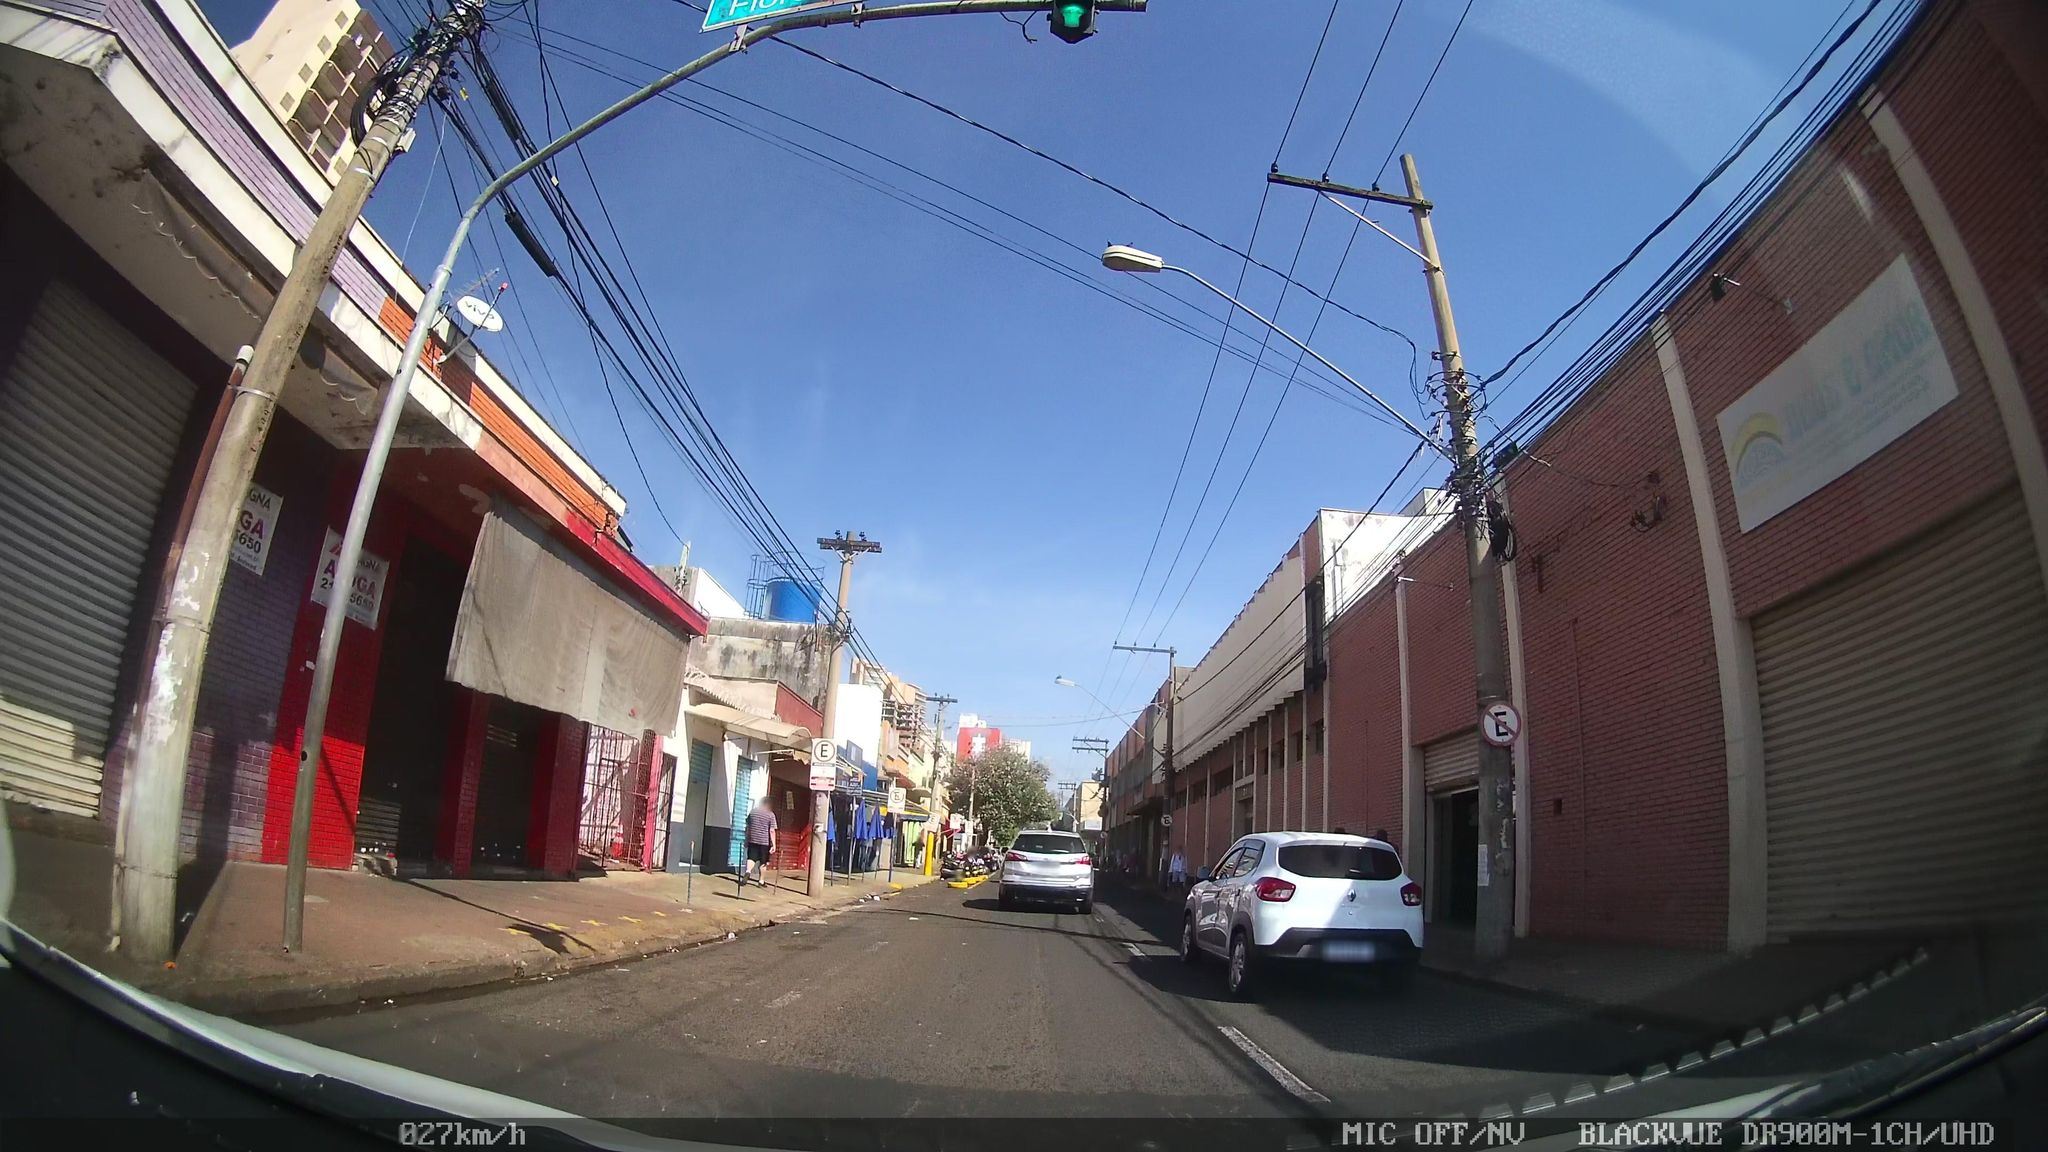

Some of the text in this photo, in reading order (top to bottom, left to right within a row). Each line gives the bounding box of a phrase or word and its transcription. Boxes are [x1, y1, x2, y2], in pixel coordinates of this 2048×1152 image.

[465, 300, 495, 320] vivo
[249, 488, 271, 509] GNA
[240, 510, 265, 540] GA
[235, 529, 262, 554] 5650
[1493, 711, 1509, 737] E
[820, 743, 829, 758] E
